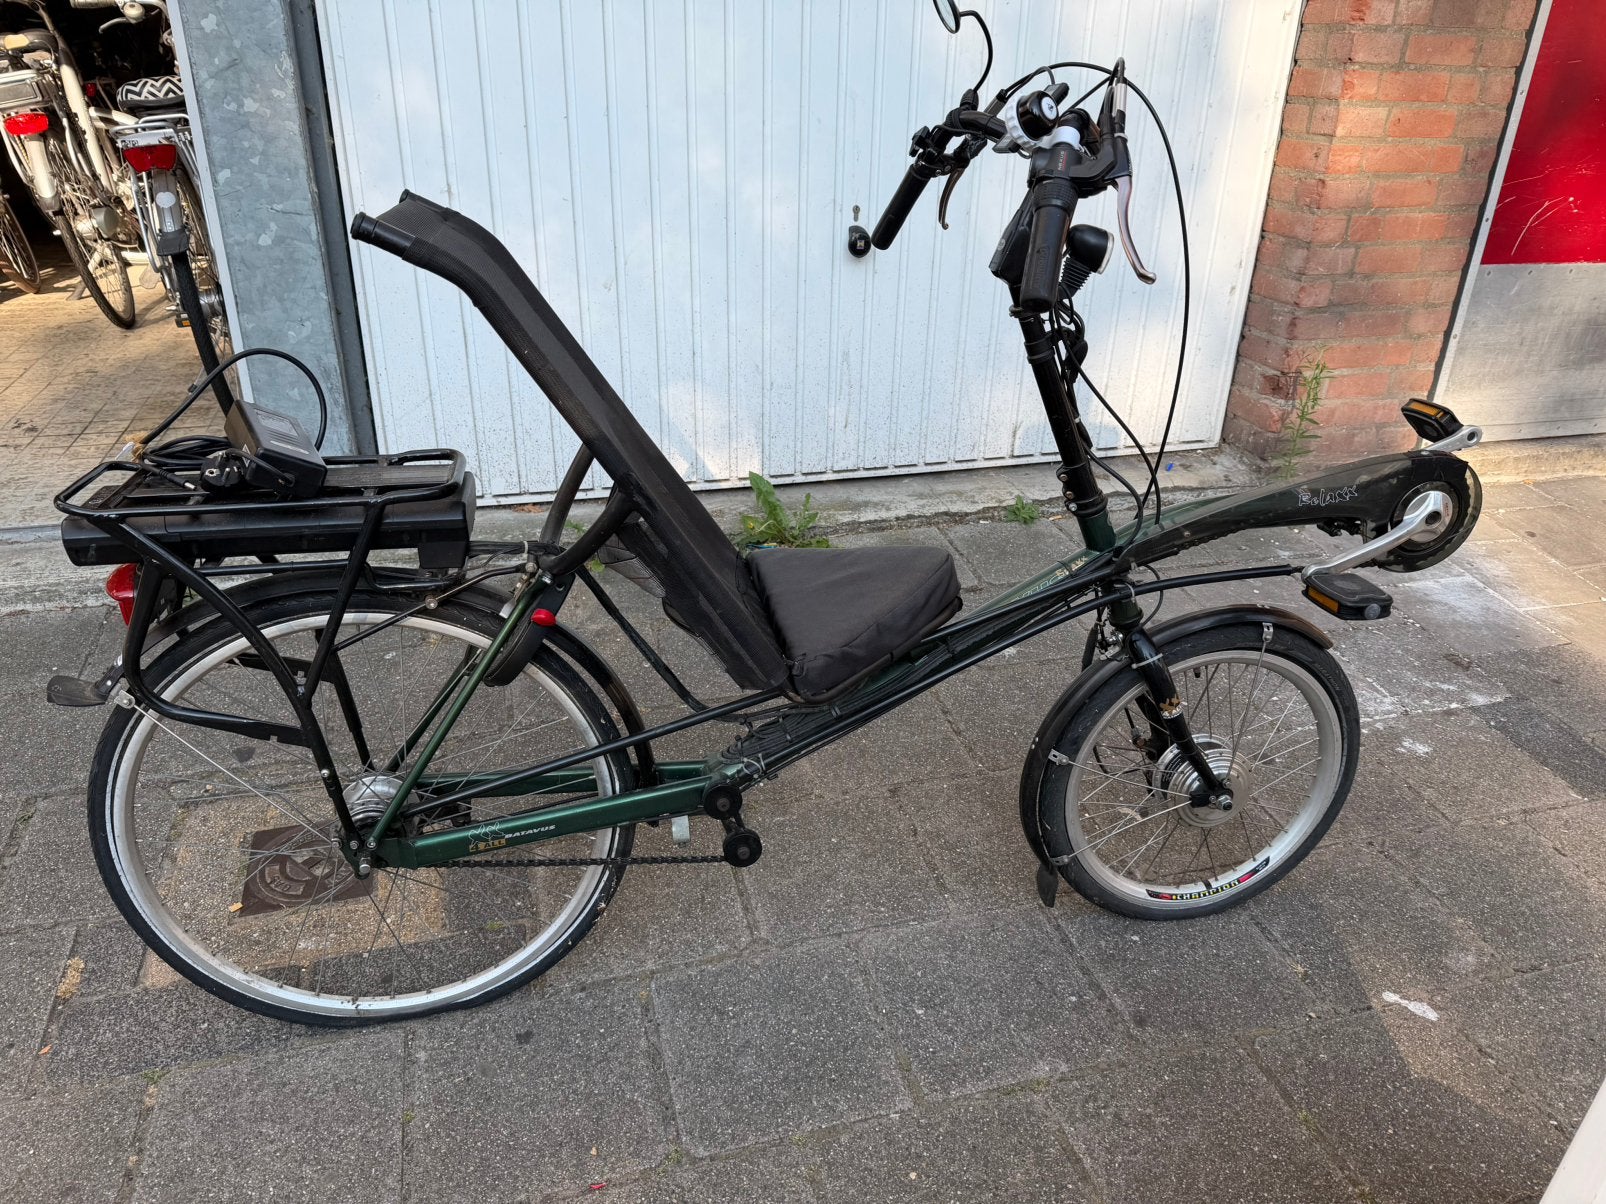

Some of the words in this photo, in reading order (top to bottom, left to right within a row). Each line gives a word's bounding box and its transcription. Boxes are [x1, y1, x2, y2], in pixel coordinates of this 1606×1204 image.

[504, 824, 556, 839] BATAVUS
[483, 840, 506, 850] ALL
[1177, 879, 1239, 900] CHAMPION
